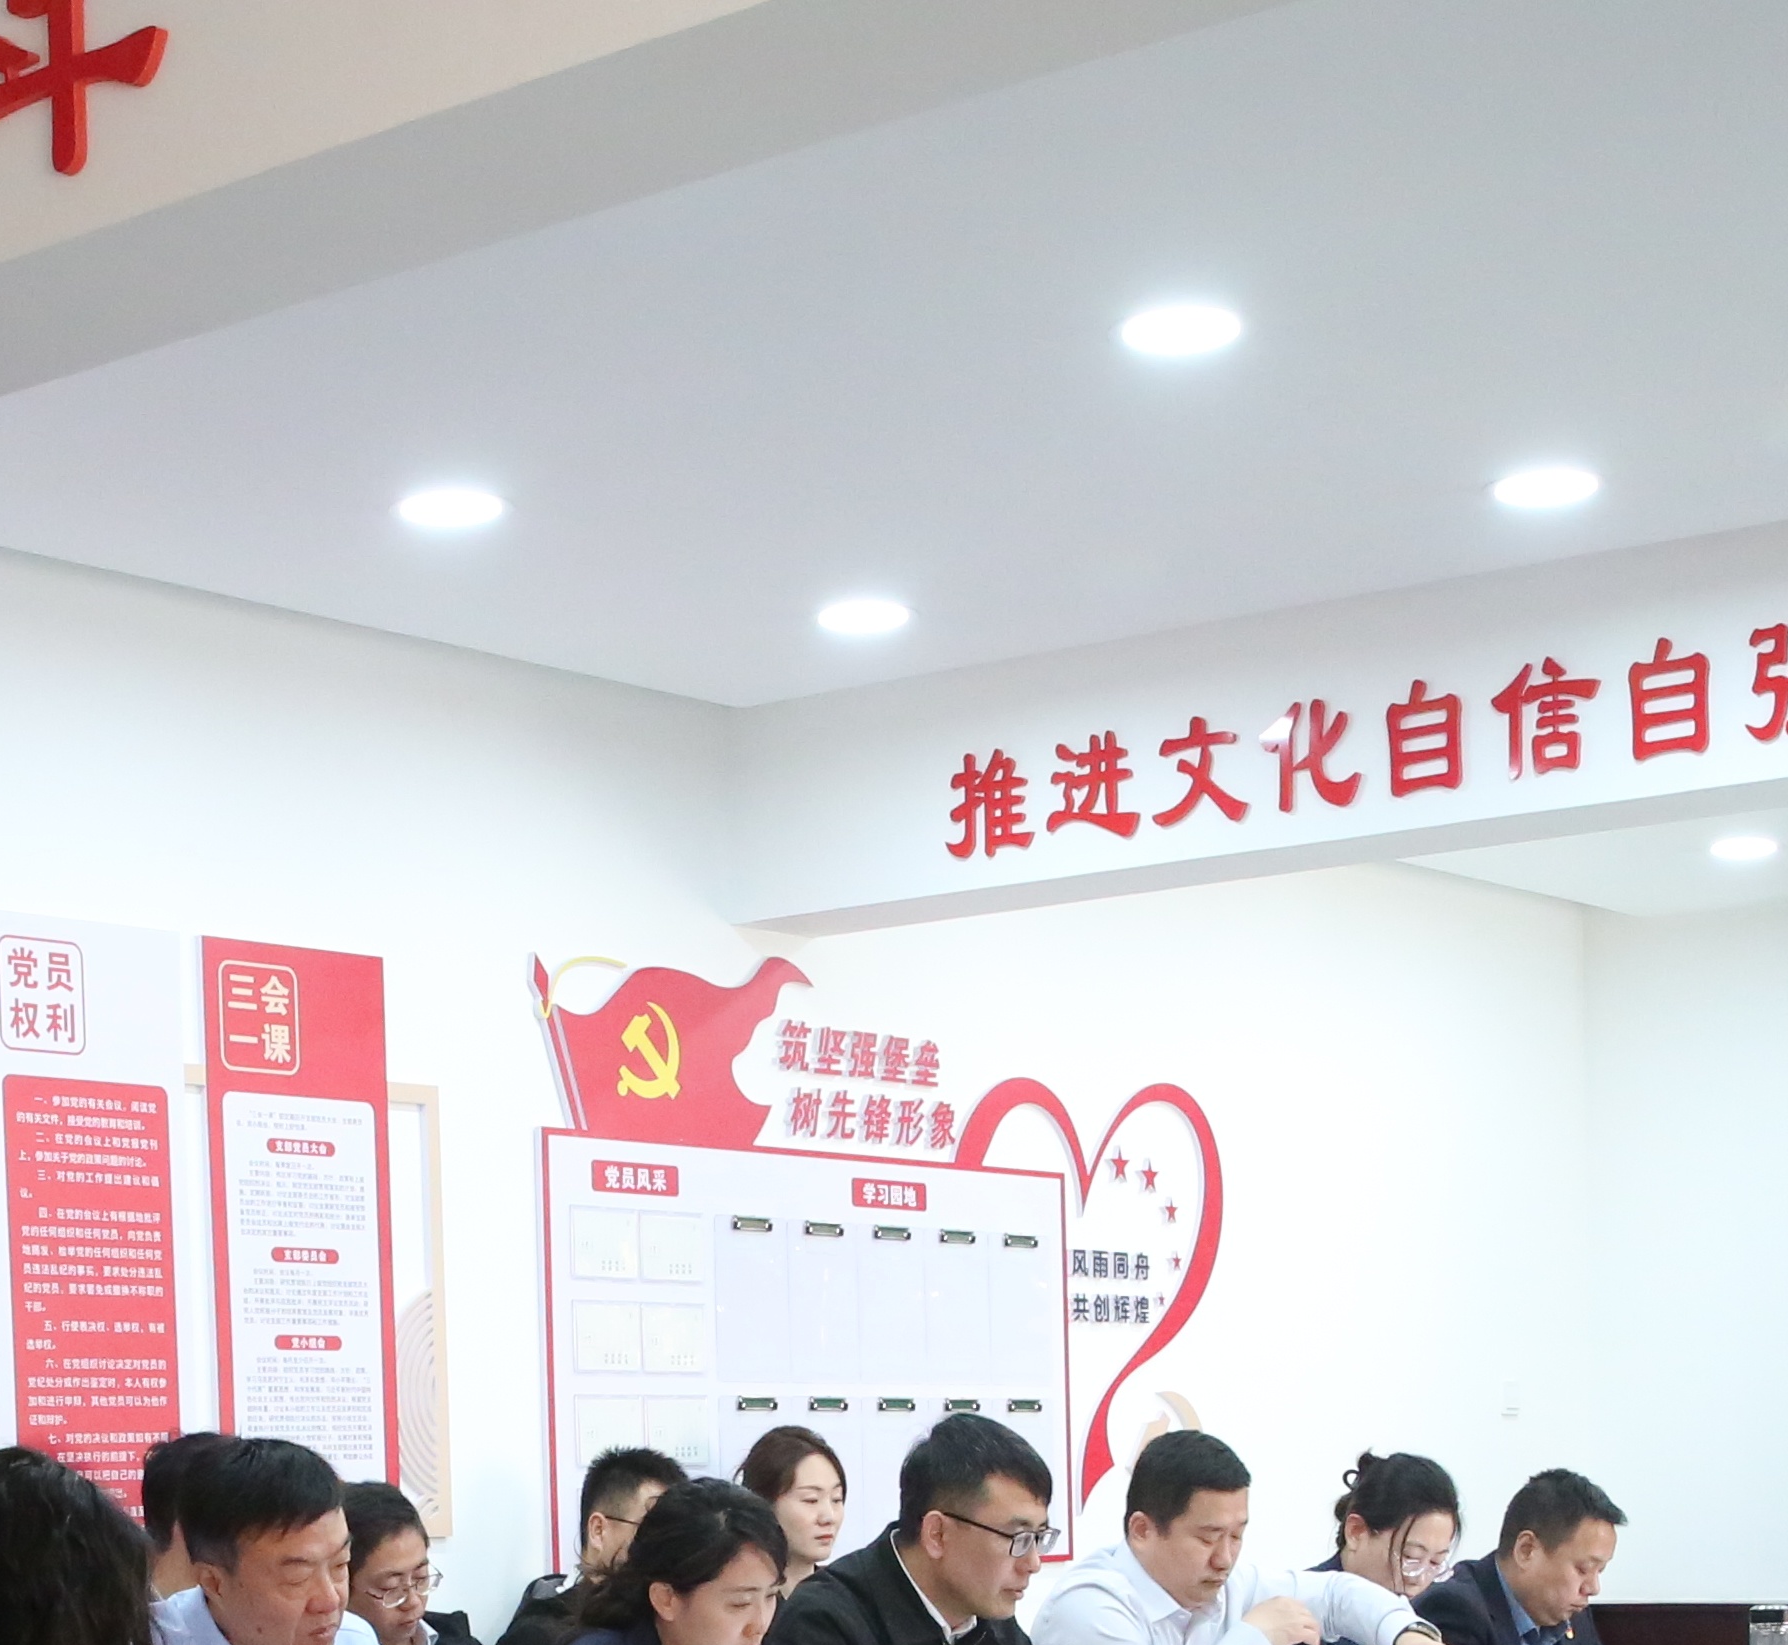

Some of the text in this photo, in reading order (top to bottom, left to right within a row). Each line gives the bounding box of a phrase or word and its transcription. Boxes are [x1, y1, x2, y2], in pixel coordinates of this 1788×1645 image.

[8, 947, 74, 992] 党员
[228, 974, 289, 1016] 三会
[10, 998, 75, 1043] 权利
[229, 1023, 291, 1063] 一课
[779, 1020, 940, 1087] 筑坚强堡垒
[791, 1088, 956, 1149] 树先锋形象
[275, 1140, 327, 1155] 支部党员大会
[604, 1165, 667, 1192] 党员风采
[863, 1183, 917, 1207] 学习园地
[284, 1250, 327, 1262] 支部委员会
[1072, 1249, 1150, 1280] 风雨同舟
[1073, 1294, 1150, 1323] 共创辉煌
[291, 1337, 325, 1349] 党小组会
